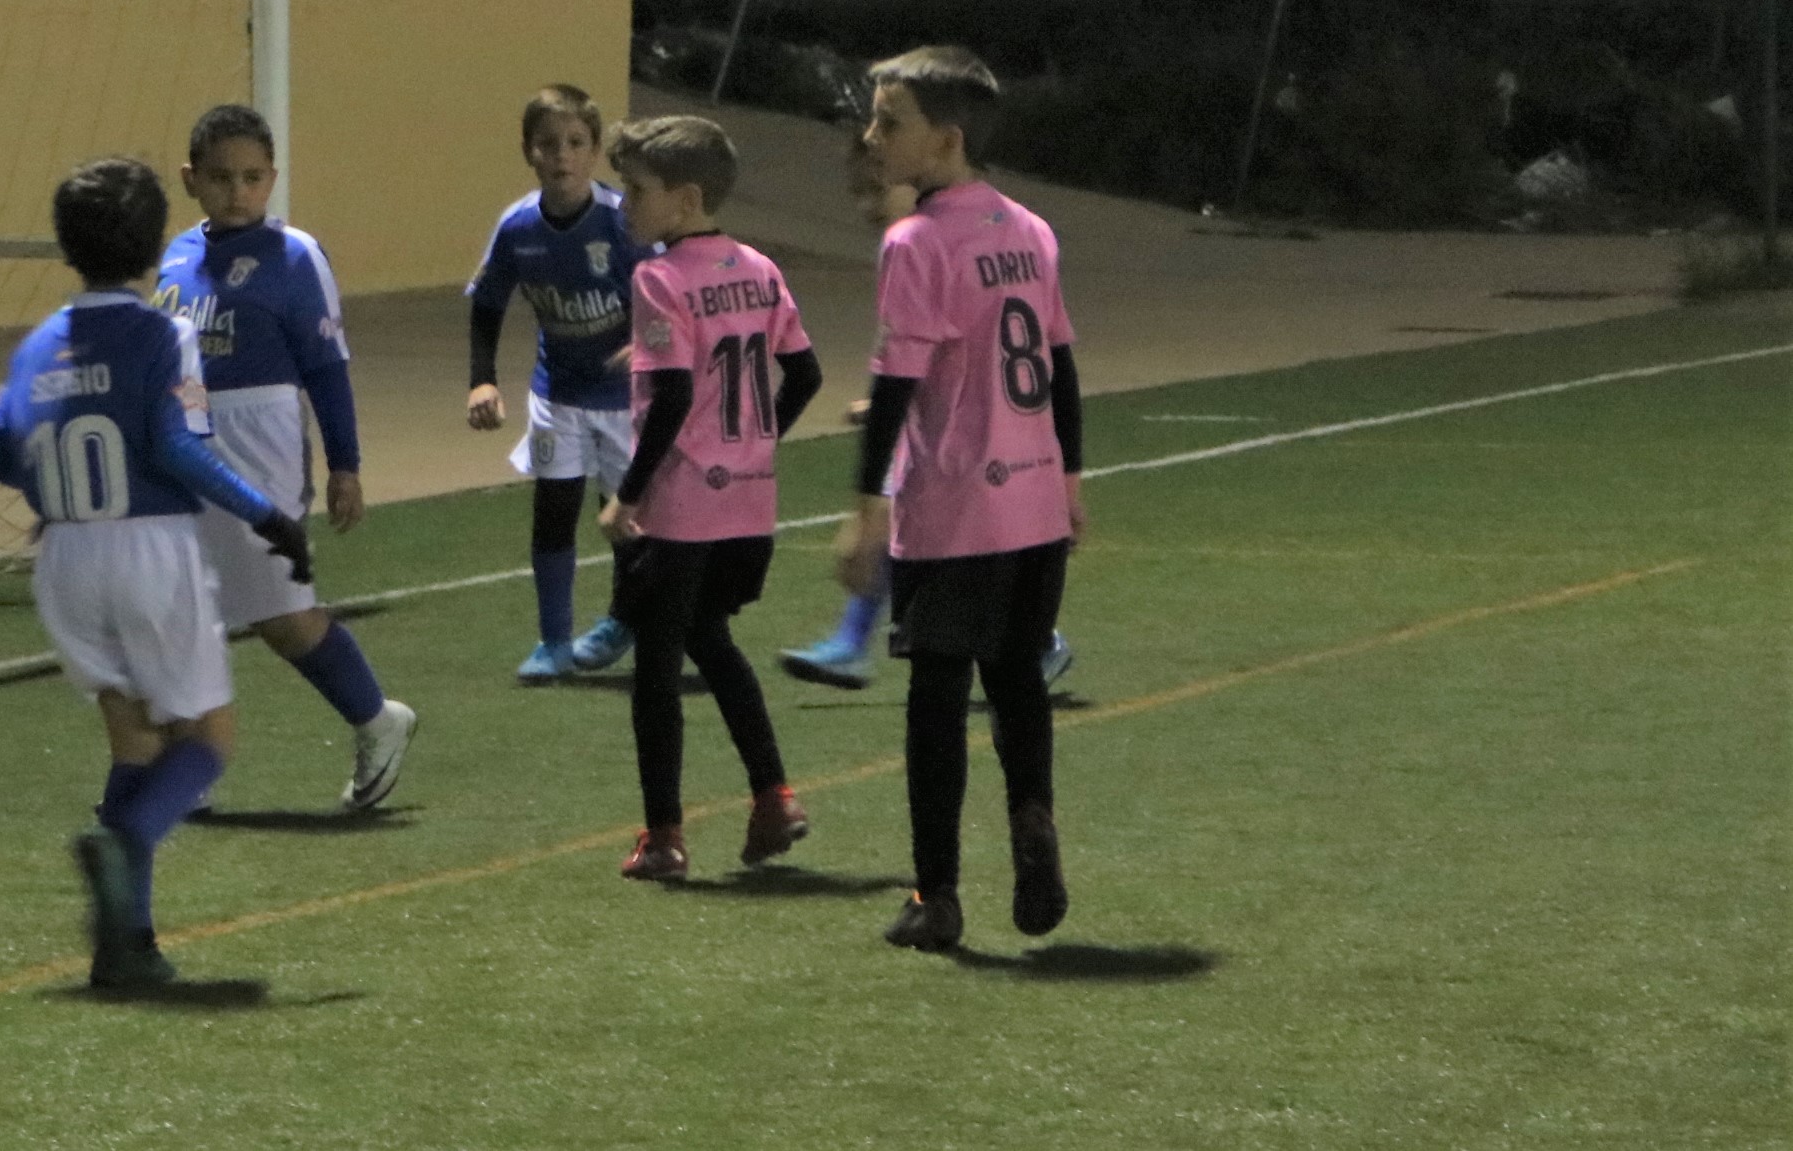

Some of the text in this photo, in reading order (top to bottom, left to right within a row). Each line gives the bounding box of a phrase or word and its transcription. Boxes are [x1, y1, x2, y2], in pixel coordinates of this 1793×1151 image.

[708, 332, 777, 443] 11
[1000, 297, 1050, 415] 8
[24, 414, 130, 521] 10
